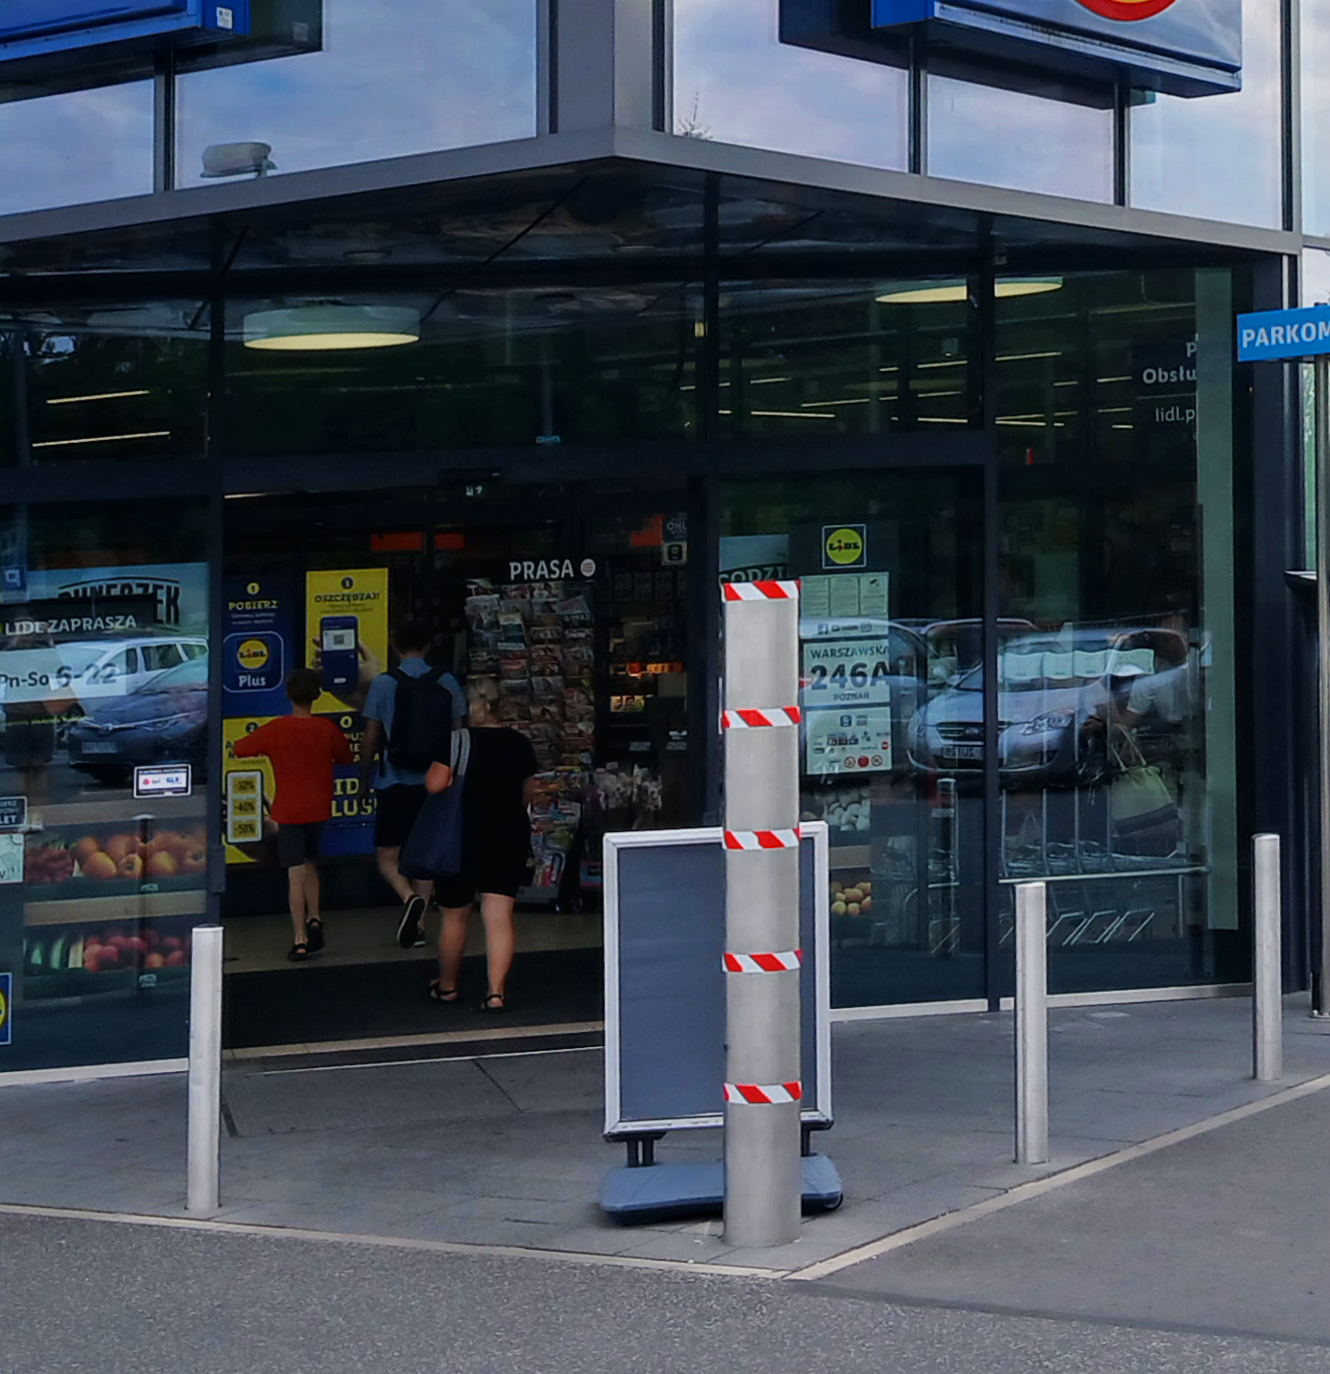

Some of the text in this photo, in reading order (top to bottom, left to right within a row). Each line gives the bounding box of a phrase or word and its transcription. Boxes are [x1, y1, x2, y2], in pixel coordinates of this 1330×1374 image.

[509, 559, 575, 581] PRASA
[228, 599, 278, 611] POBIERZ
[48, 614, 137, 634] ZAPRASZA
[238, 674, 266, 688] Plus
[810, 661, 889, 691] 246A
[331, 797, 378, 817] LUS!
